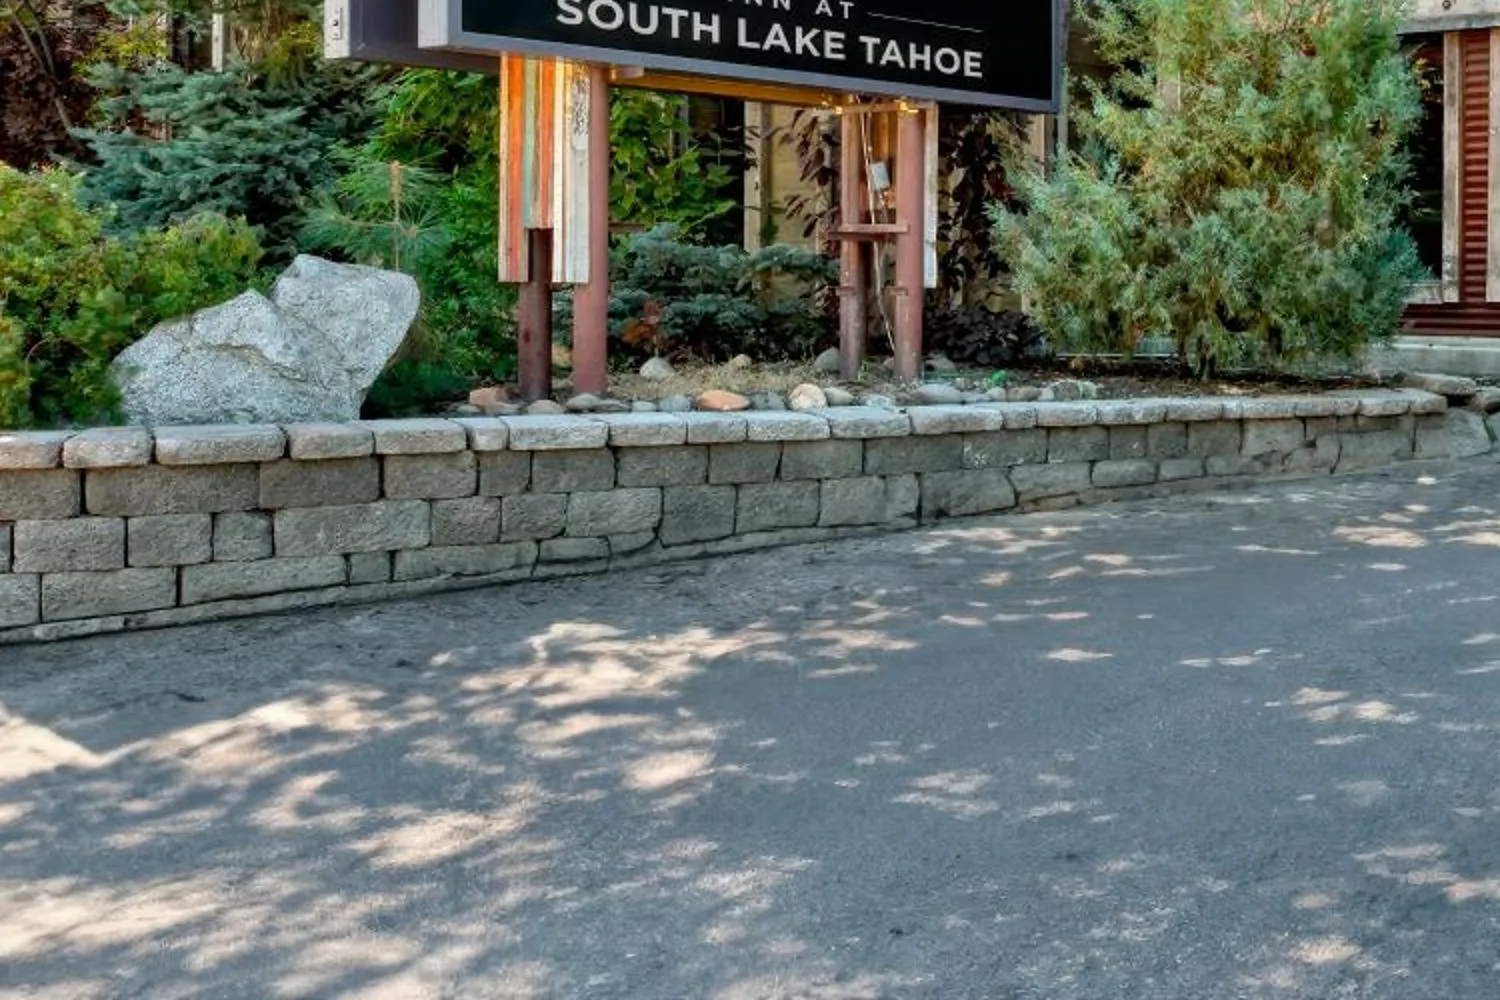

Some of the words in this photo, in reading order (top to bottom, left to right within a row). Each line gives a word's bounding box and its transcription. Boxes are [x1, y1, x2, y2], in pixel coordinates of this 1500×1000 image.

[815, 0, 855, 19] AT
[737, 16, 846, 61] LAKE
[859, 35, 983, 79] TAHOE
